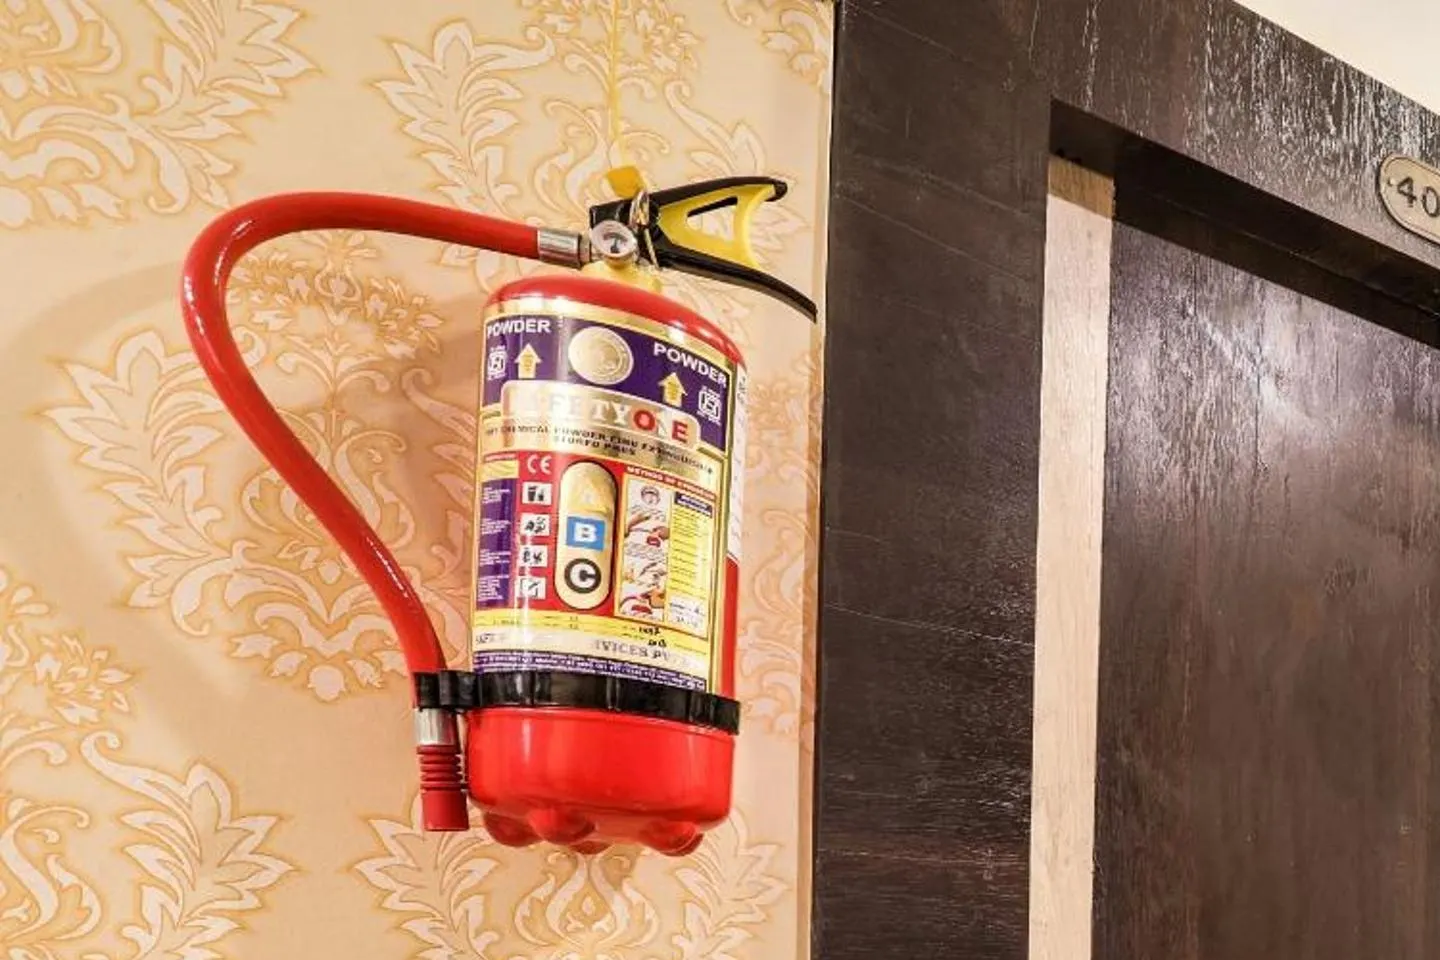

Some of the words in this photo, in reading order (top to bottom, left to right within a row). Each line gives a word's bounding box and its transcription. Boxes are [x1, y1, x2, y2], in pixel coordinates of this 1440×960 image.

[487, 317, 552, 338] POWDER
[652, 342, 727, 388] POWDER
[573, 521, 598, 543] B
[569, 563, 596, 589] C
